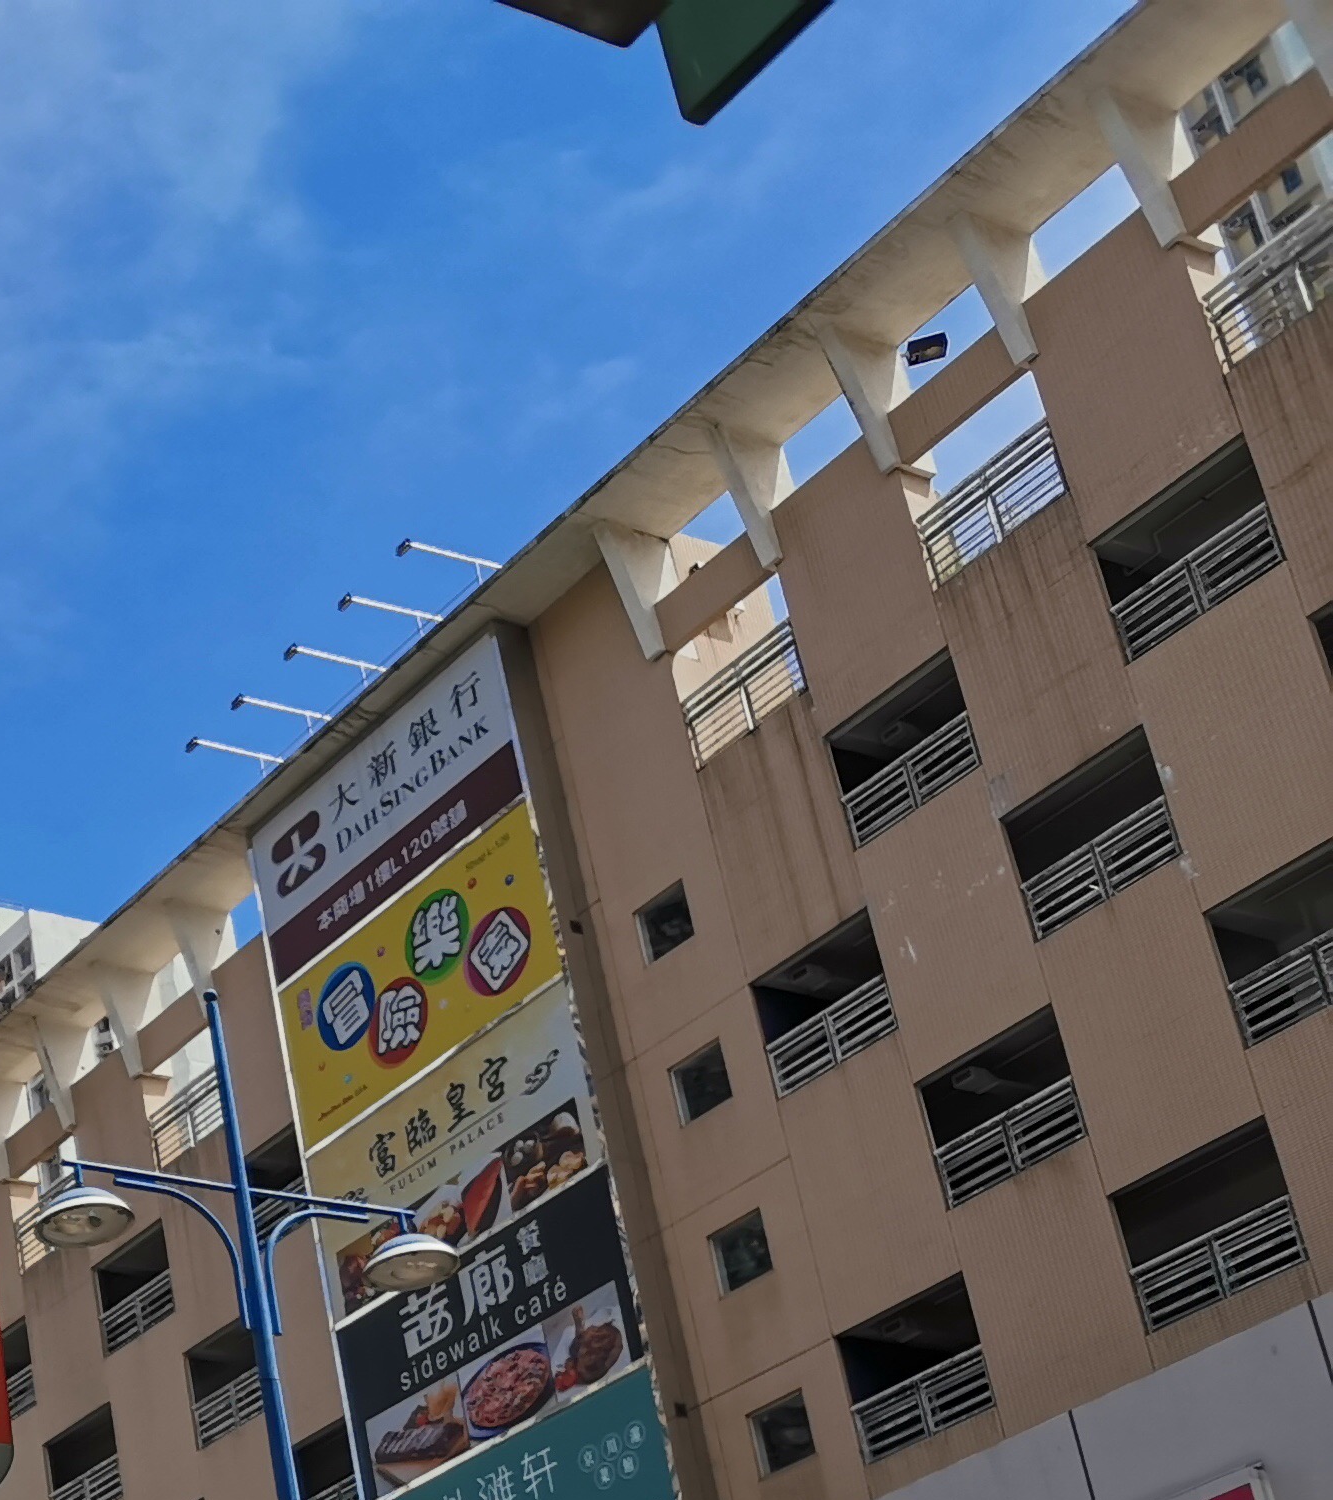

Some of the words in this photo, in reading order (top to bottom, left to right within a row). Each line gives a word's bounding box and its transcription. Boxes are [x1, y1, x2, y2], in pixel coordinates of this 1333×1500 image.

[329, 671, 481, 824] 大新銀行
[336, 808, 379, 854] DAH
[380, 766, 429, 817] SING
[429, 716, 490, 777] BANK
[369, 1056, 508, 1178] 富臨皇宮
[389, 1159, 438, 1195] FULUM
[449, 1112, 506, 1155] PALACE
[400, 1316, 504, 1391] sidewalk
[514, 1274, 568, 1326] café
